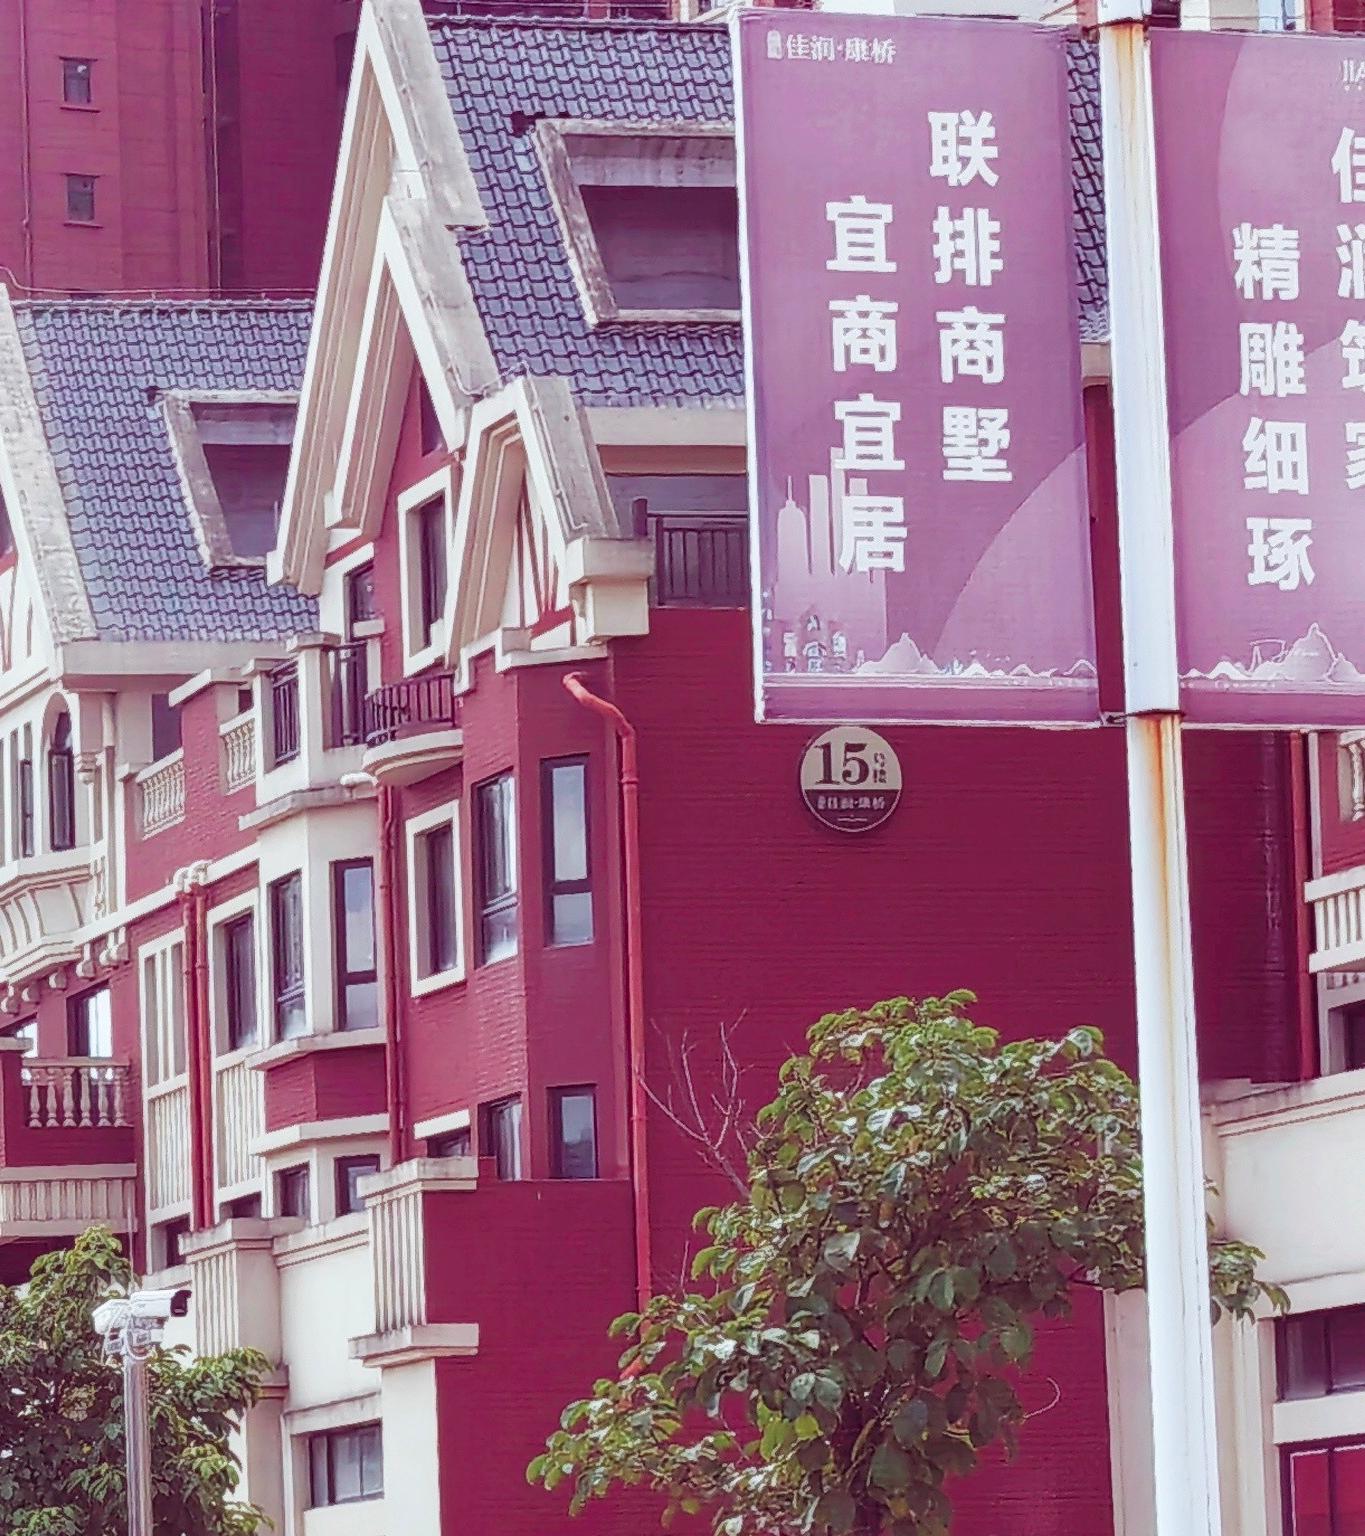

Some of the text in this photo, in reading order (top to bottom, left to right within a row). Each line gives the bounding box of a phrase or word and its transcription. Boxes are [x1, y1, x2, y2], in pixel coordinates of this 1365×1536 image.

[824, 194, 909, 575] 宜商宜居
[927, 110, 1013, 484] 联排商墅
[1232, 221, 1316, 591] 精雕细琢
[813, 741, 870, 785] 15
